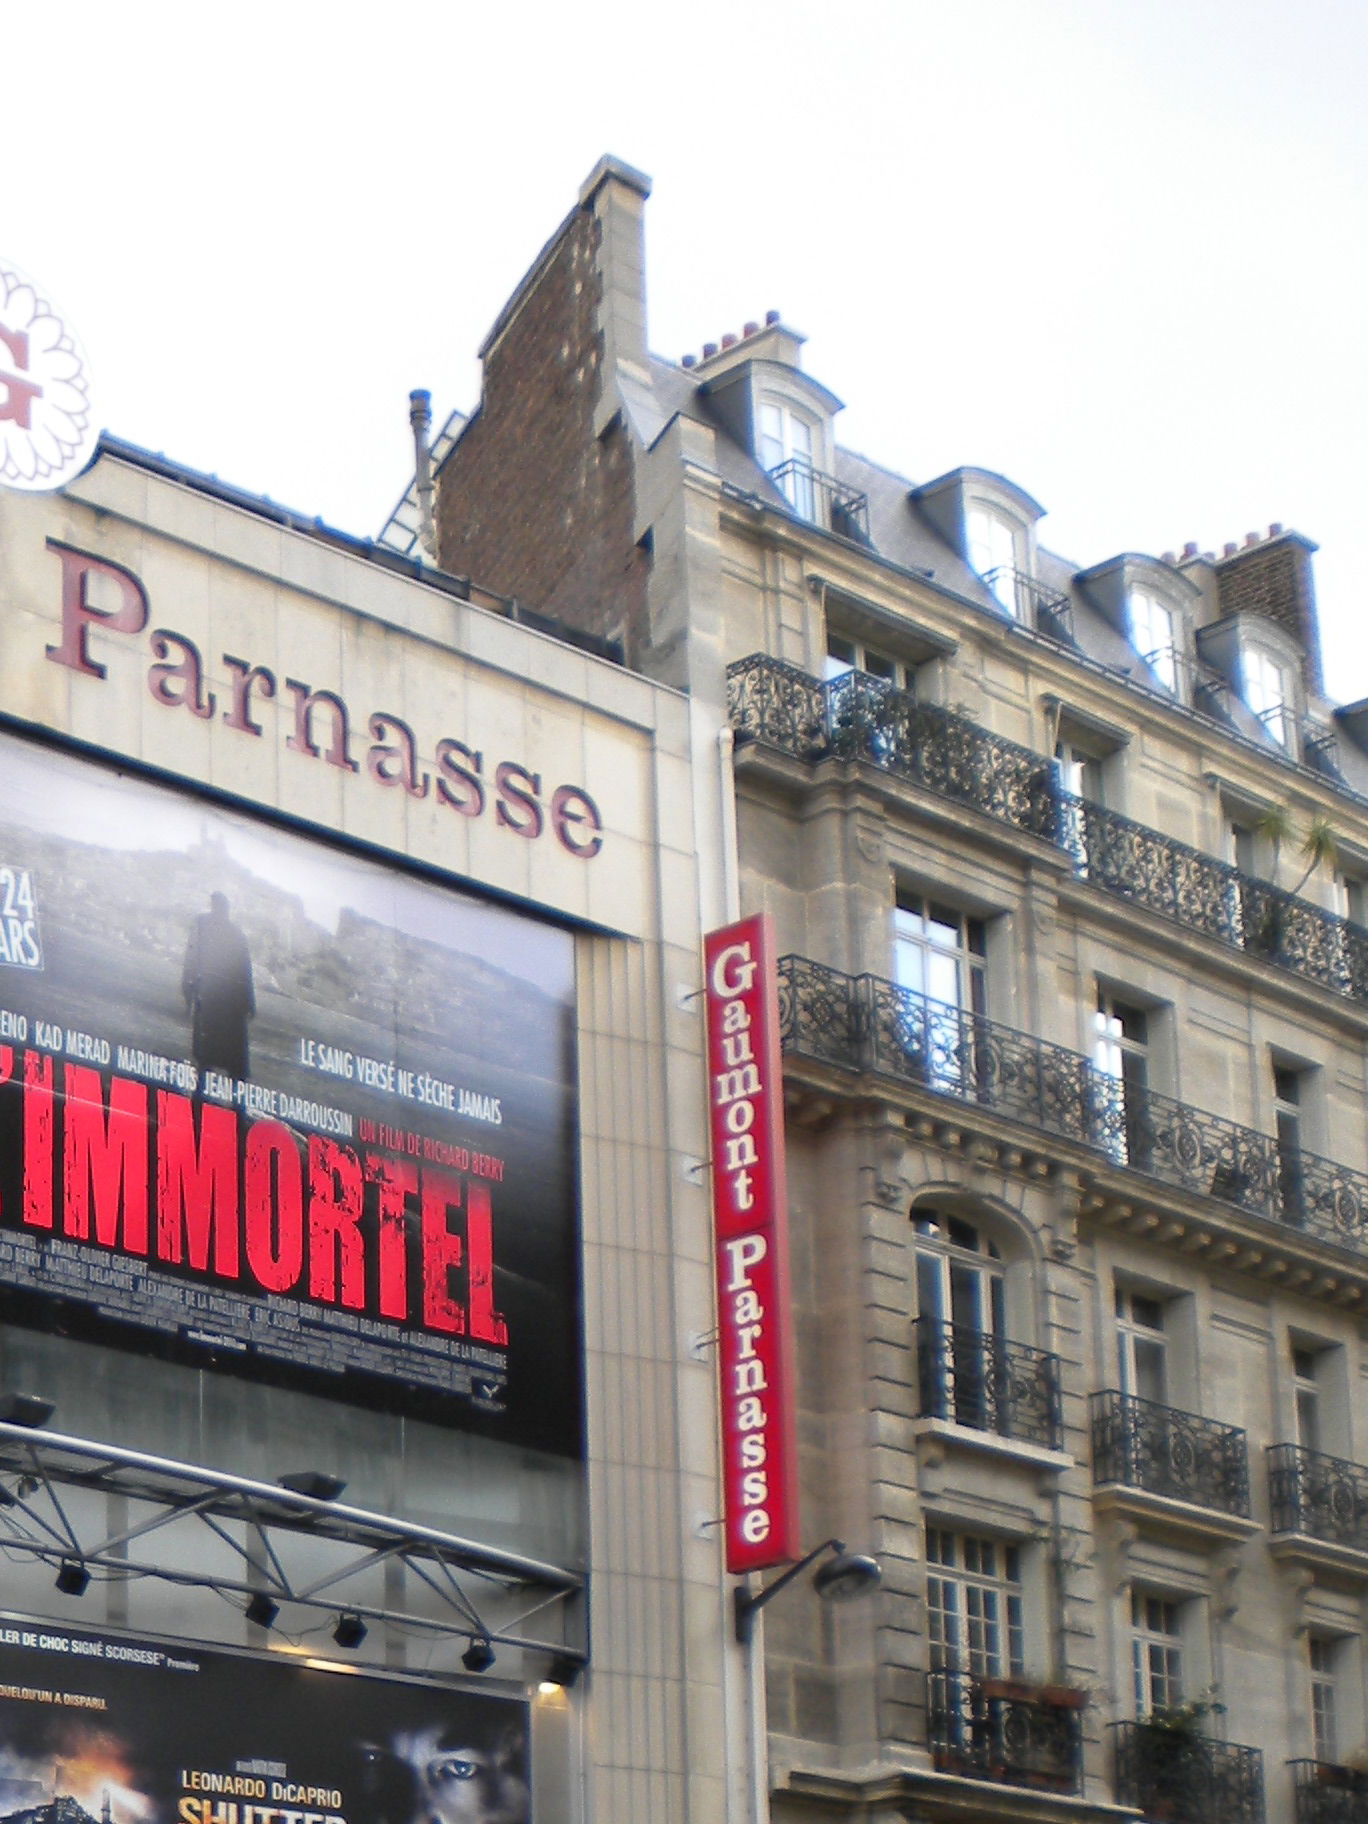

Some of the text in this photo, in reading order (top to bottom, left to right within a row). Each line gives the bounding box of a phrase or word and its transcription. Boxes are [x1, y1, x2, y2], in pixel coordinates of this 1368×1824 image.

[45, 536, 602, 858] Parnasse
[35, 1020, 62, 1050] KAD
[66, 1030, 110, 1064] MERAD
[203, 1071, 277, 1114] JEAN-PIERRE
[280, 1093, 353, 1137] DARROUSSIN
[300, 1038, 502, 1125] LE SANG VERSÉ NE SÈCHE JAMAIS
[359, 1117, 504, 1182] UN FILM DE RICHARD BERRY
[713, 942, 771, 1546] Gaumont Parnasse
[23, 1633, 37, 1648] DE
[40, 1634, 69, 1652] CHOC
[71, 1640, 103, 1657] SIGNÉ
[54, 1692, 62, 1705] A
[182, 1770, 343, 1809] LEONARDO DiCAPRIO
